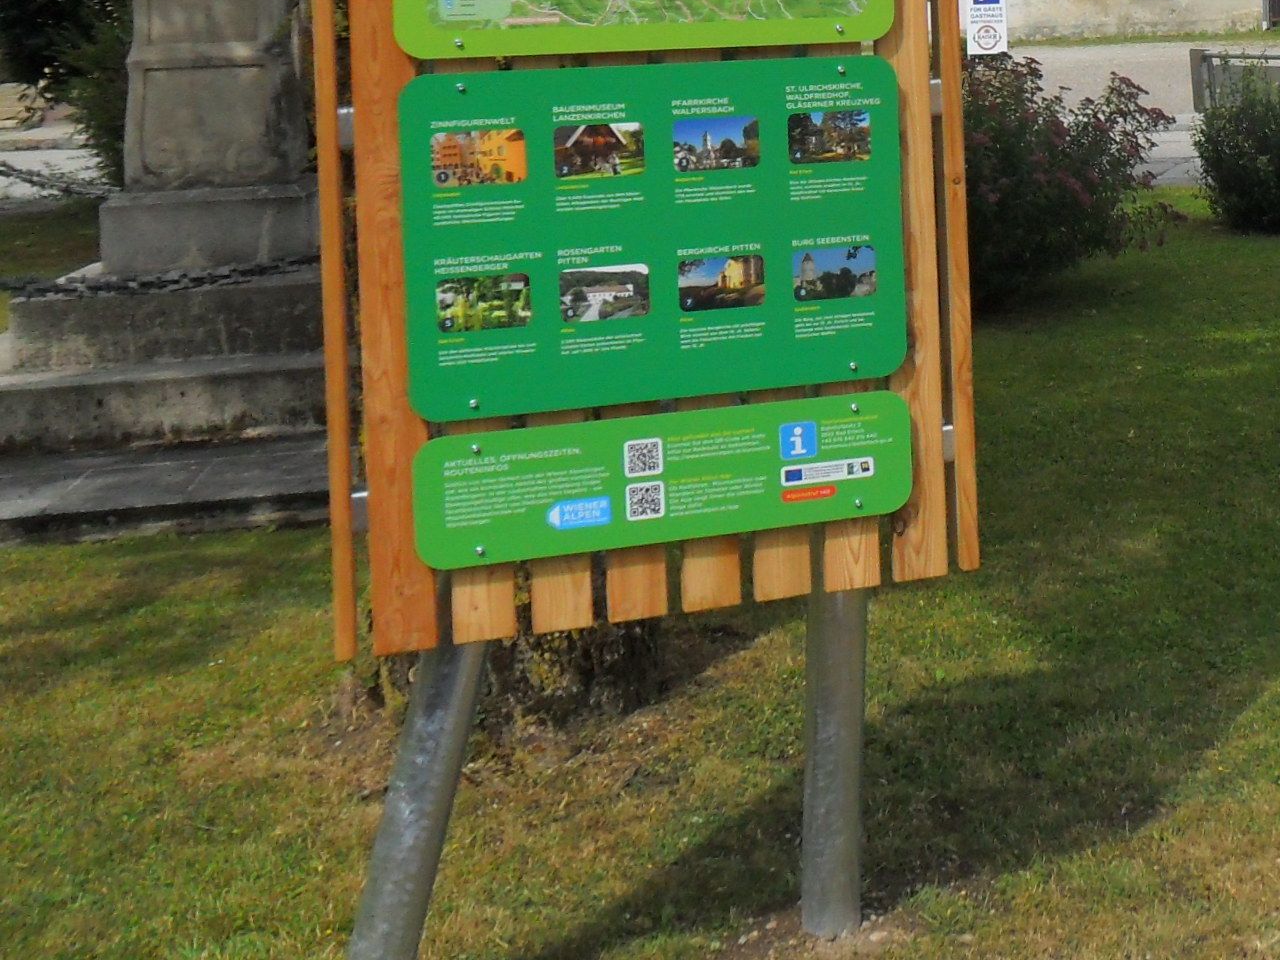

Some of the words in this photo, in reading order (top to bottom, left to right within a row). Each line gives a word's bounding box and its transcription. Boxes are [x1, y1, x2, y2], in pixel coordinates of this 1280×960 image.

[552, 103, 626, 113] BAUERNMUSEUM
[671, 97, 730, 107] PFARRKIRCHE
[835, 97, 882, 107] KREUZWEG
[672, 105, 735, 116] WALPERSBACH
[430, 117, 516, 129] ZINNFIGURENWELT
[791, 237, 815, 247] BURG
[816, 234, 870, 245] SEEBENSTEIN
[557, 245, 623, 256] ROSENGARTEN
[677, 246, 730, 256] BERGKIRCHE
[731, 243, 761, 252] PITTEN
[433, 251, 543, 266] KRÄUTERSCHAUGARTEN
[557, 256, 589, 265] PITTEN
[434, 263, 509, 275] HEISSENBERGER
[562, 499, 608, 512] WIENER
[563, 510, 600, 522] ALPEN
